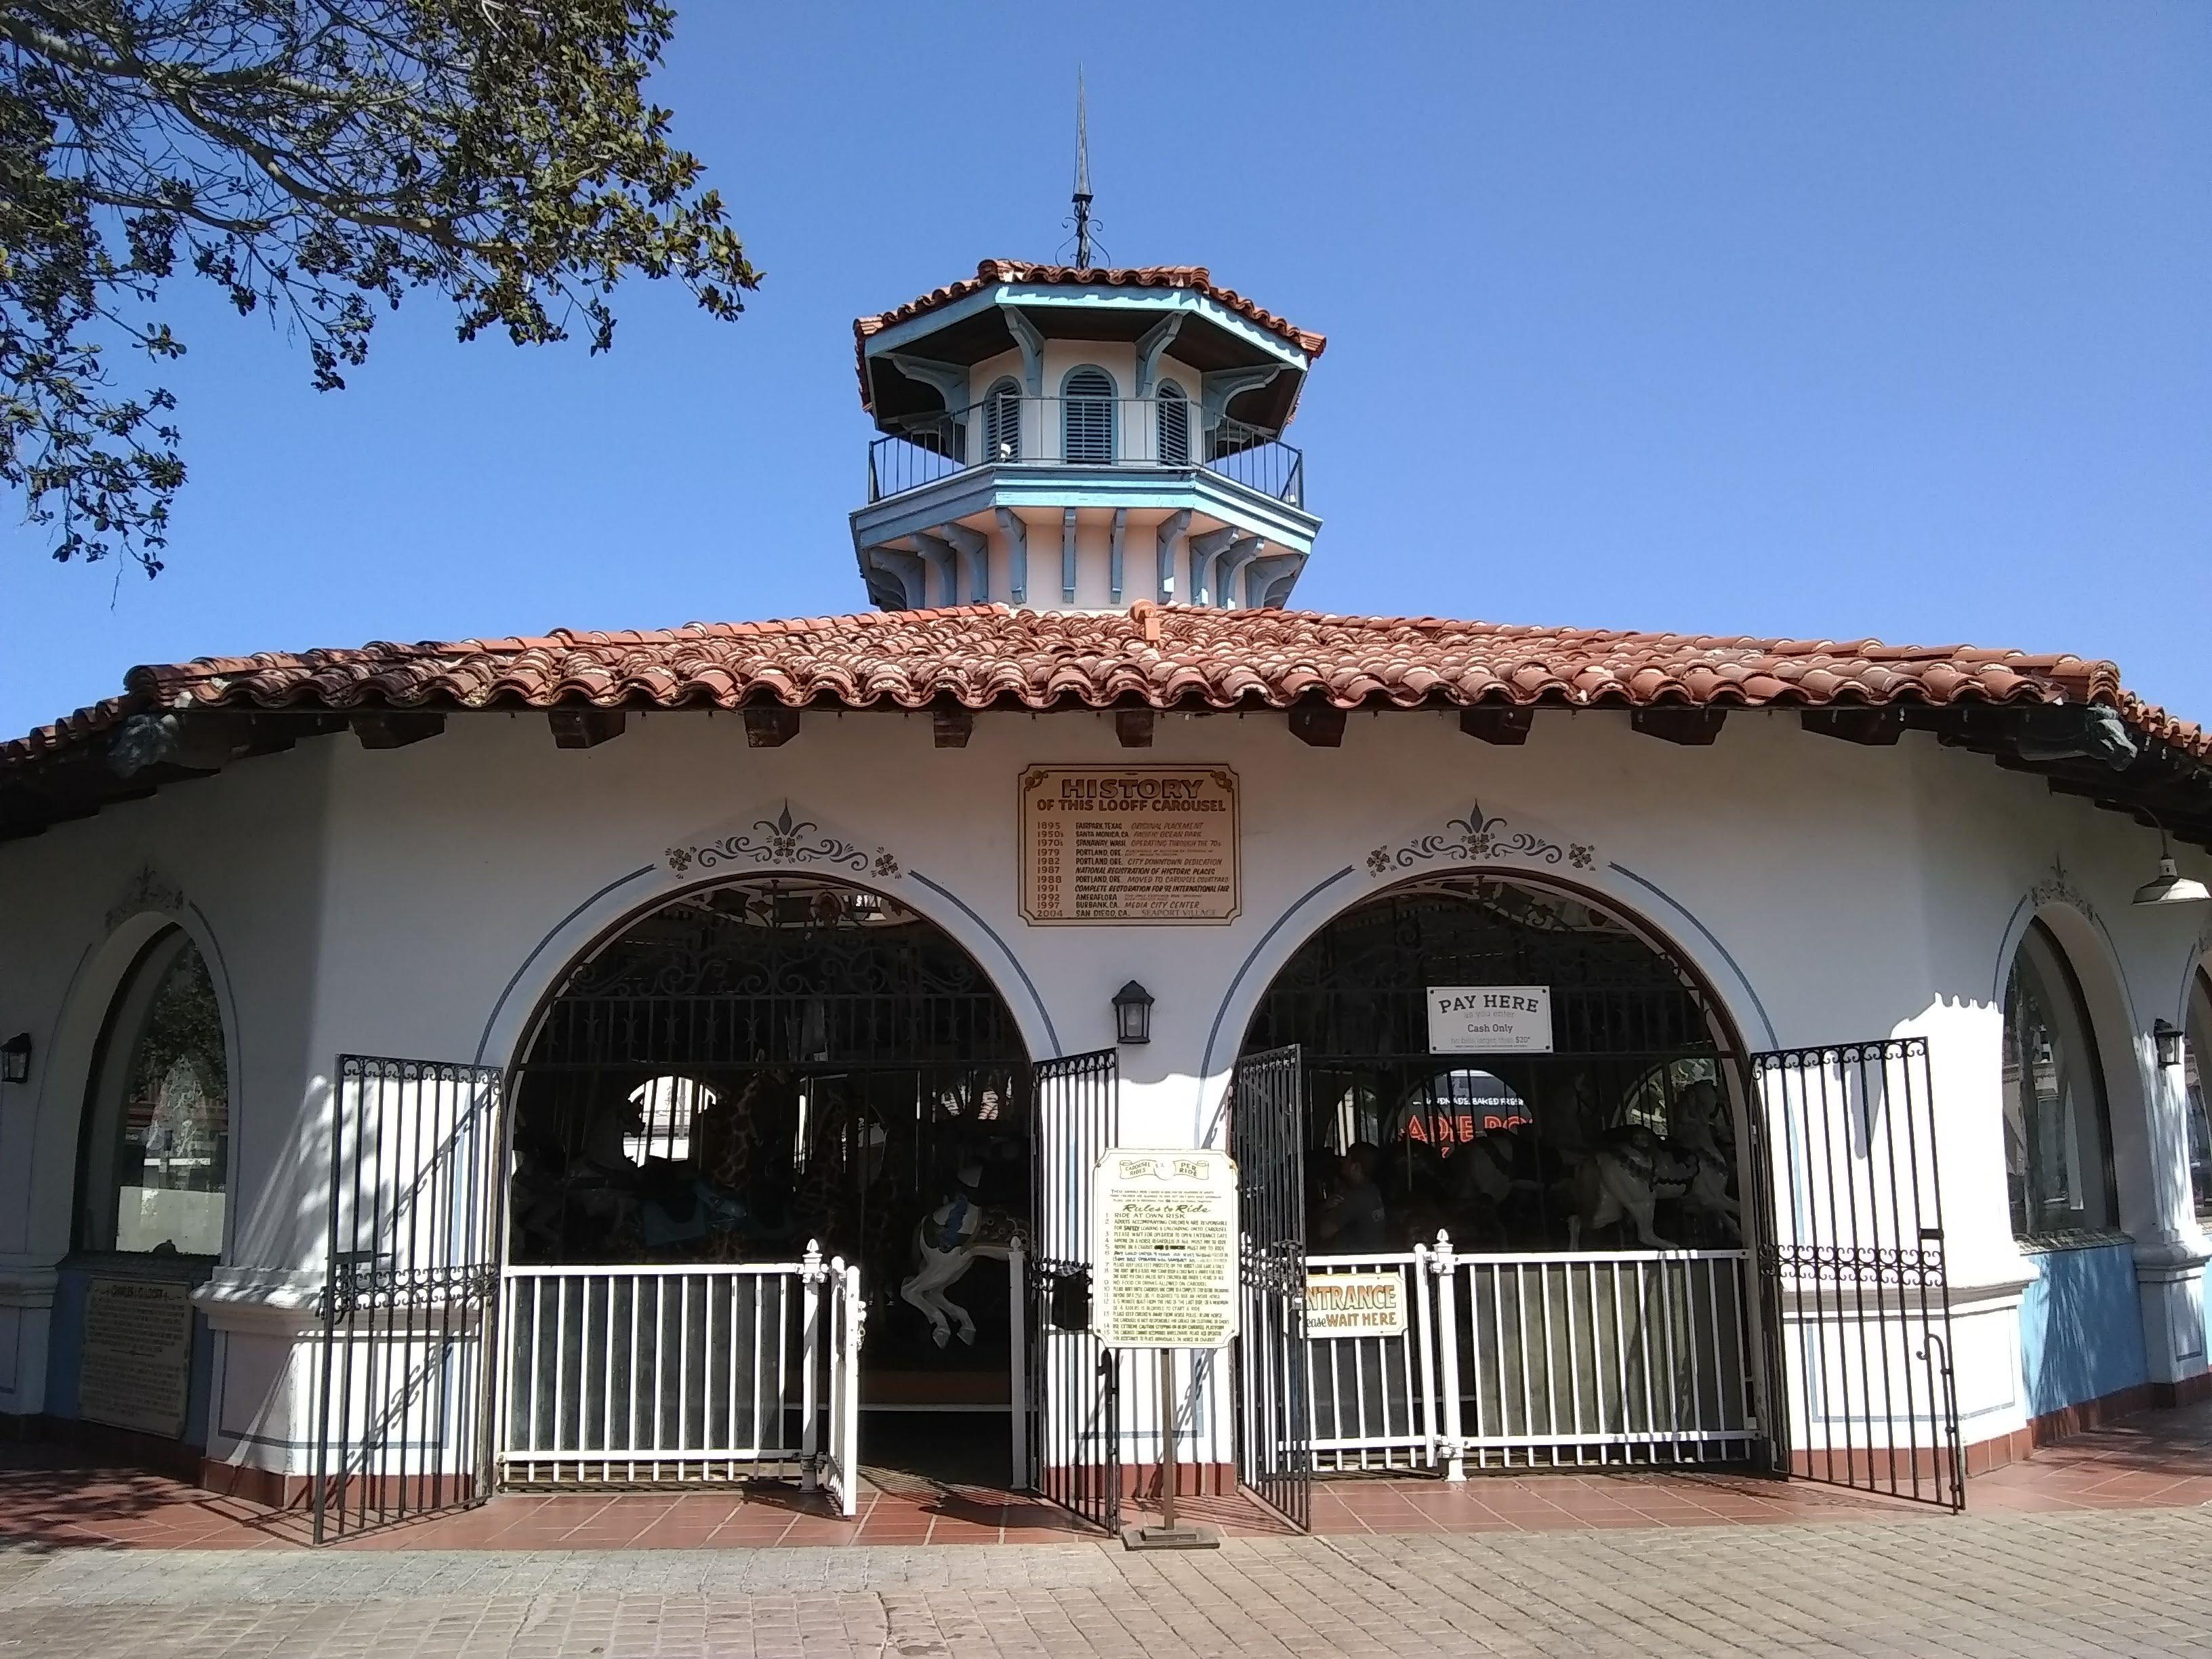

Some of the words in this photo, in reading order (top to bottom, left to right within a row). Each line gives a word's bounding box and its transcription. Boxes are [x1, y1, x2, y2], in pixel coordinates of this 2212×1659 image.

[1061, 779, 1204, 798] HISTORY
[1037, 800, 1054, 811] OF
[1059, 799, 1094, 811] THIS
[1099, 799, 1147, 812] LOOFF
[1152, 800, 1227, 812] CAROUSEL
[1037, 821, 1061, 830] 1895
[1438, 995, 1477, 1014] PAY
[1483, 994, 1539, 1013] HERE
[1467, 1023, 1490, 1033] Cash
[1492, 1023, 1513, 1034] Only
[1472, 1097, 1500, 1105] BAKED
[1125, 1162, 1151, 1171] CAROUSEL
[1181, 1162, 1196, 1170] PER
[1130, 1168, 1146, 1176] RIDES
[1179, 1168, 1197, 1177] RIDE
[1122, 1204, 1161, 1212] Rules
[1175, 1204, 1212, 1214] Ride
[1305, 1284, 1397, 1311] NTRANCE
[1307, 1317, 1326, 1328] ease
[1326, 1313, 1359, 1328] WAIT
[1361, 1311, 1397, 1326] HERE
